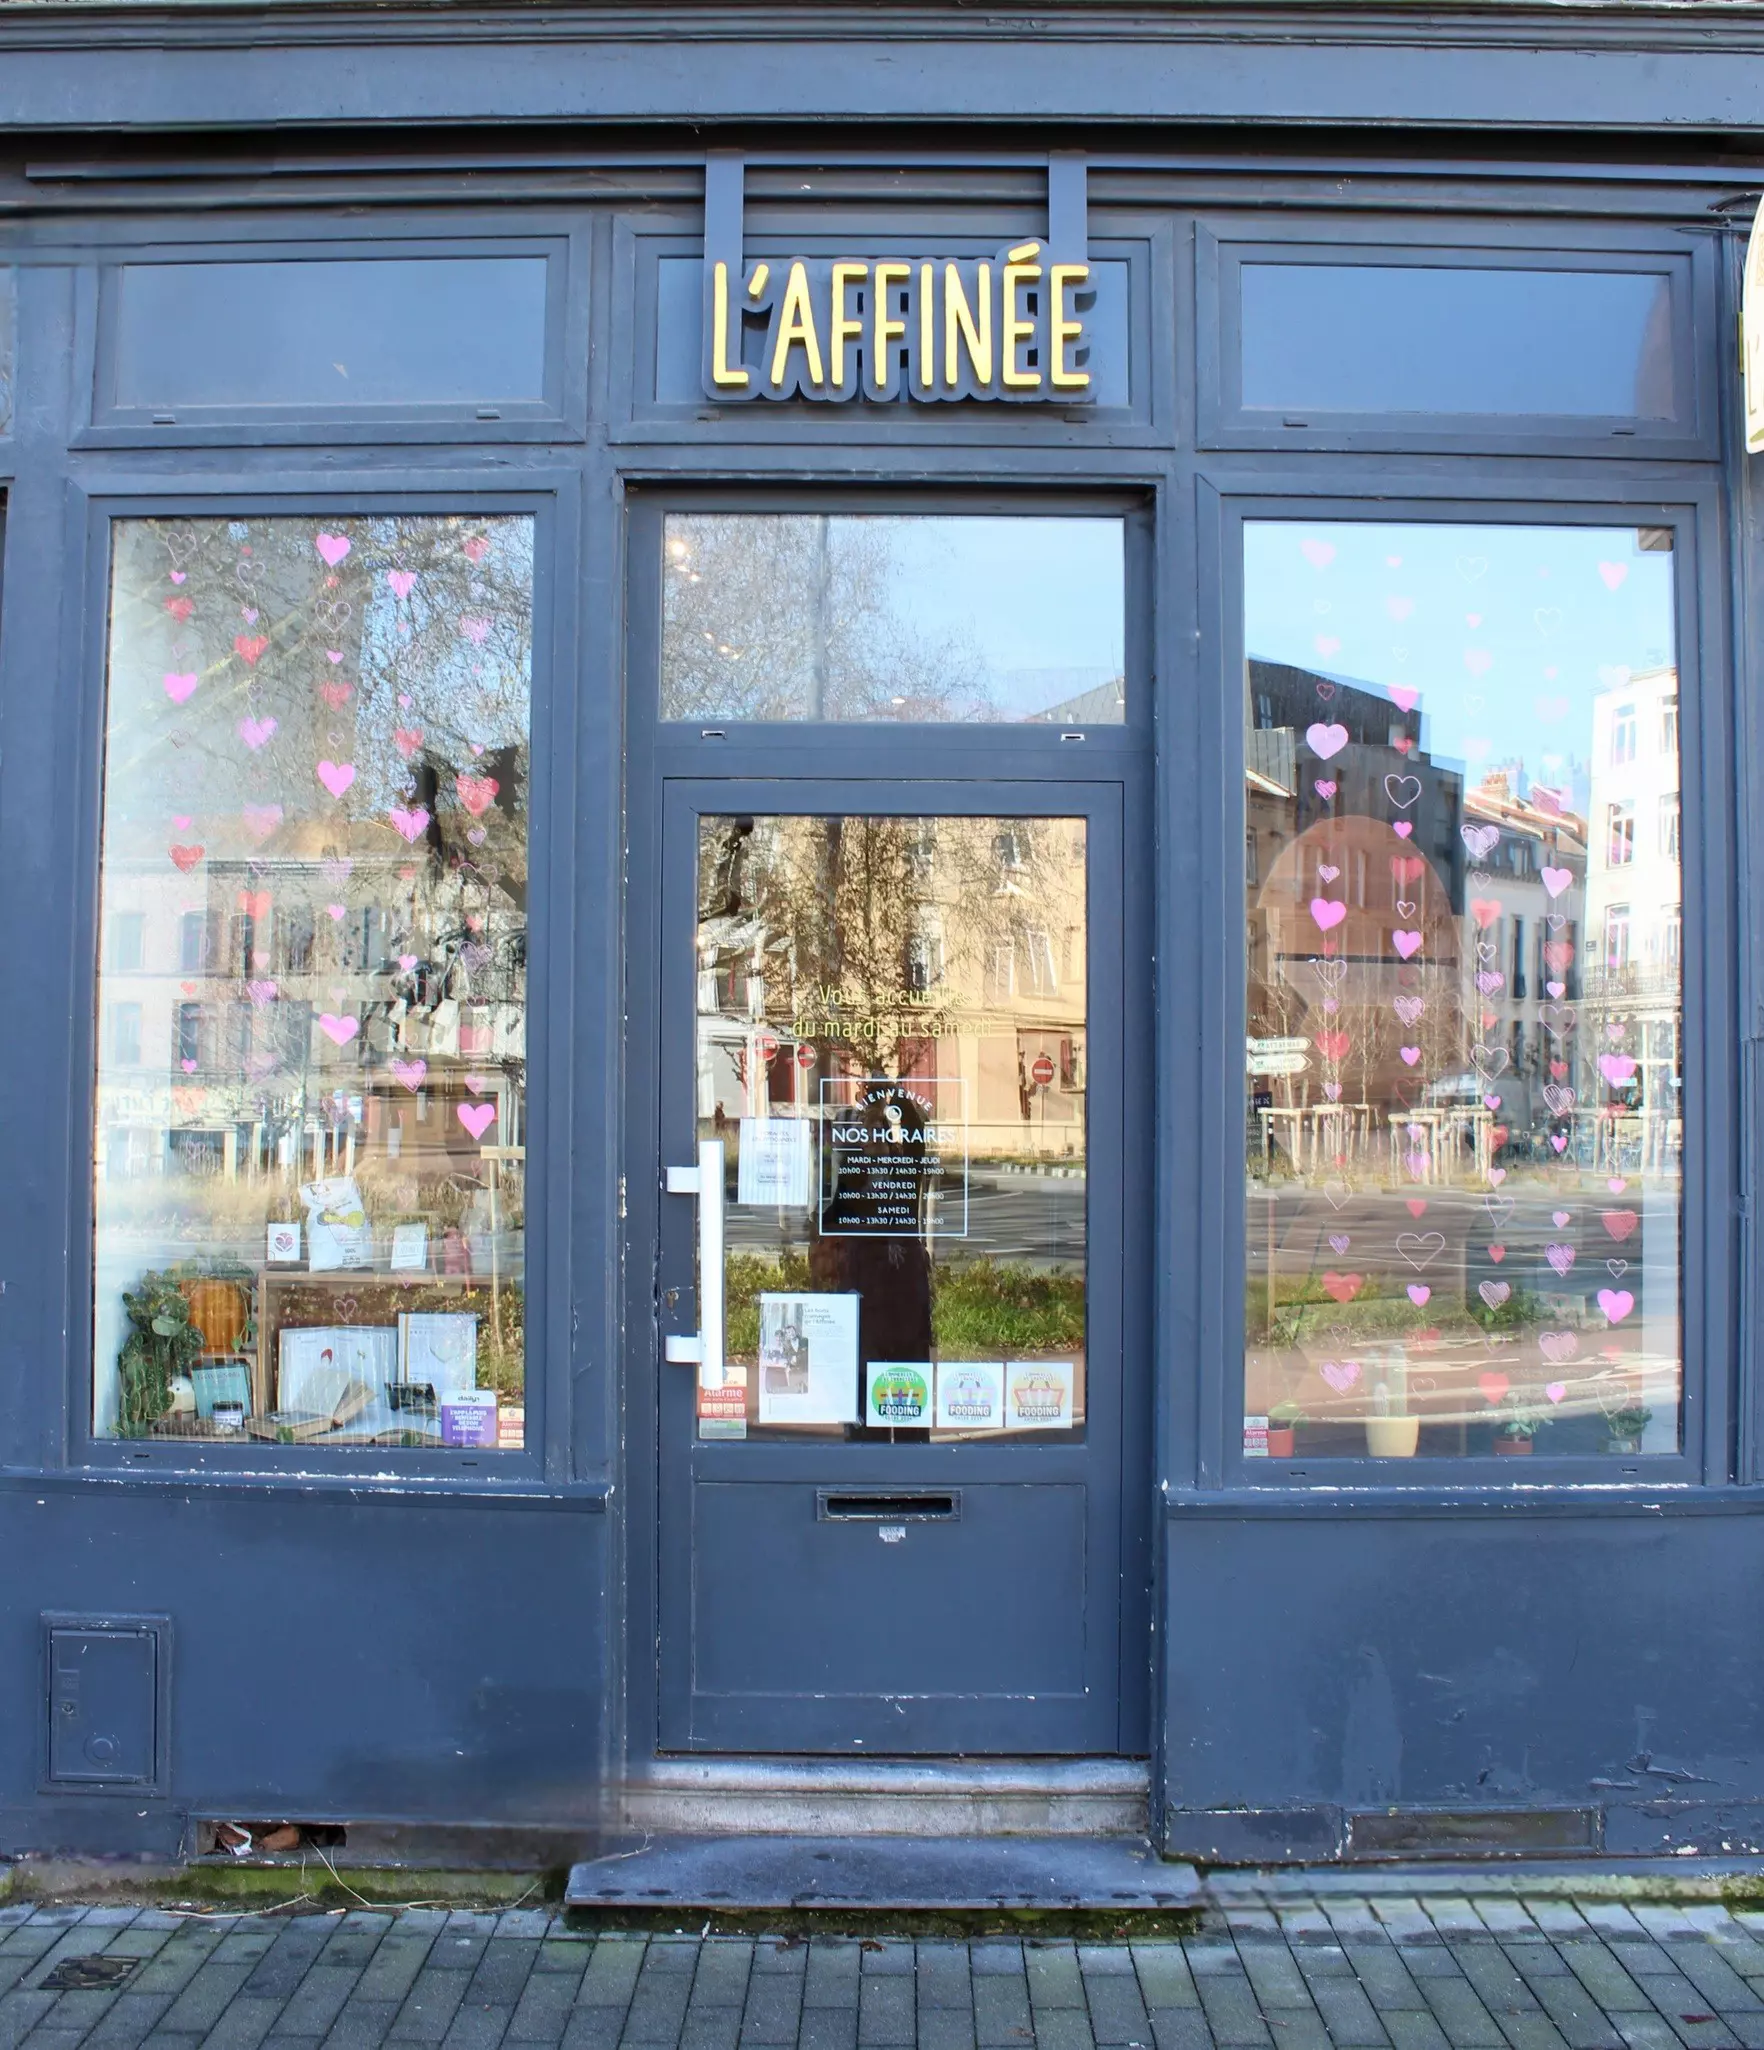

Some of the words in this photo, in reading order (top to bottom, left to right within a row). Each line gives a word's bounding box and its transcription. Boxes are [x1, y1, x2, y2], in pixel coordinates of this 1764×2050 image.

[712, 242, 1091, 387] L'AFFINÉE
[819, 984, 866, 1005] Vous
[792, 1016, 816, 1038] du
[824, 1016, 880, 1038] mardi
[889, 1022, 912, 1038] au
[921, 1017, 991, 1038] samedi
[855, 1088, 933, 1111] BIENVENUE
[832, 1128, 869, 1143] NOS
[919, 1157, 941, 1165] JEUDI
[880, 1405, 919, 1415] FOODING
[950, 1406, 989, 1415] FOODING
[1019, 1407, 1059, 1416] FOODING
